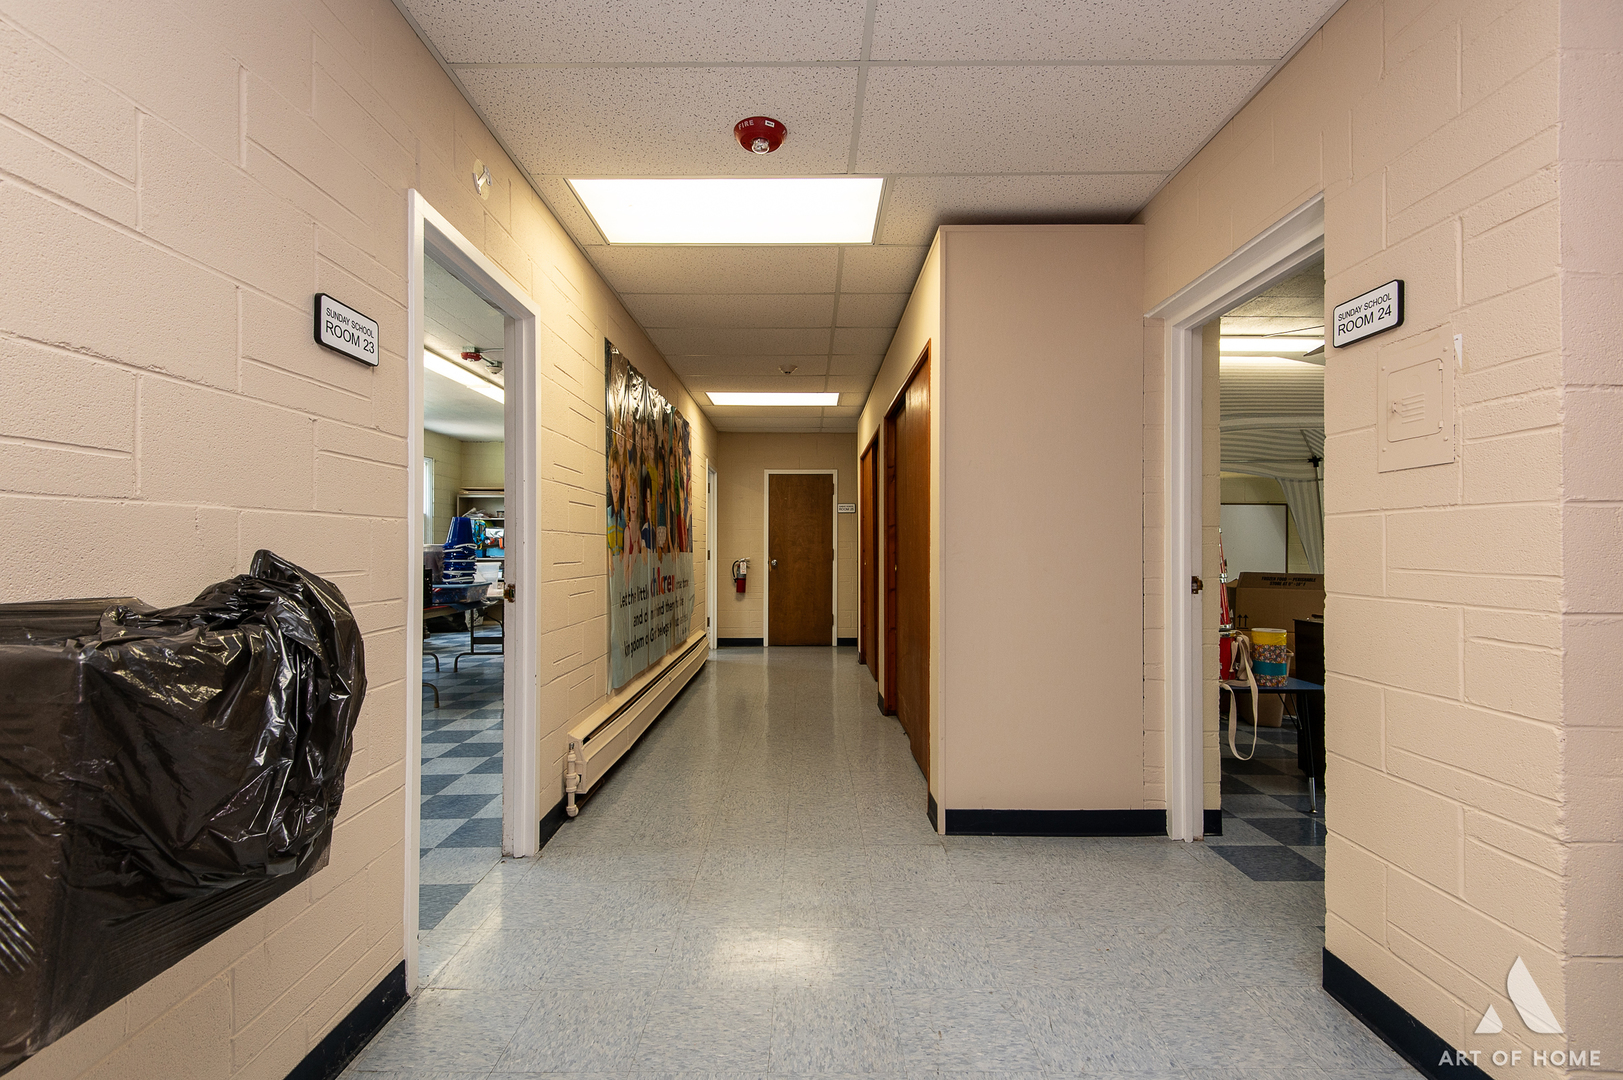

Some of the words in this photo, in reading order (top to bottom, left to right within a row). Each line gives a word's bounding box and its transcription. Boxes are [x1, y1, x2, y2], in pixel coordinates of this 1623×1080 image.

[738, 120, 754, 130] FIRE
[326, 307, 350, 326] SUNDAY
[352, 320, 374, 338] SCHOOL
[1338, 305, 1362, 322] SUNDAY
[1364, 293, 1392, 310] SCHOOL
[1338, 312, 1374, 336] ROOM
[1378, 304, 1392, 320] 24
[326, 320, 360, 348] ROOM
[363, 338, 374, 354] 23
